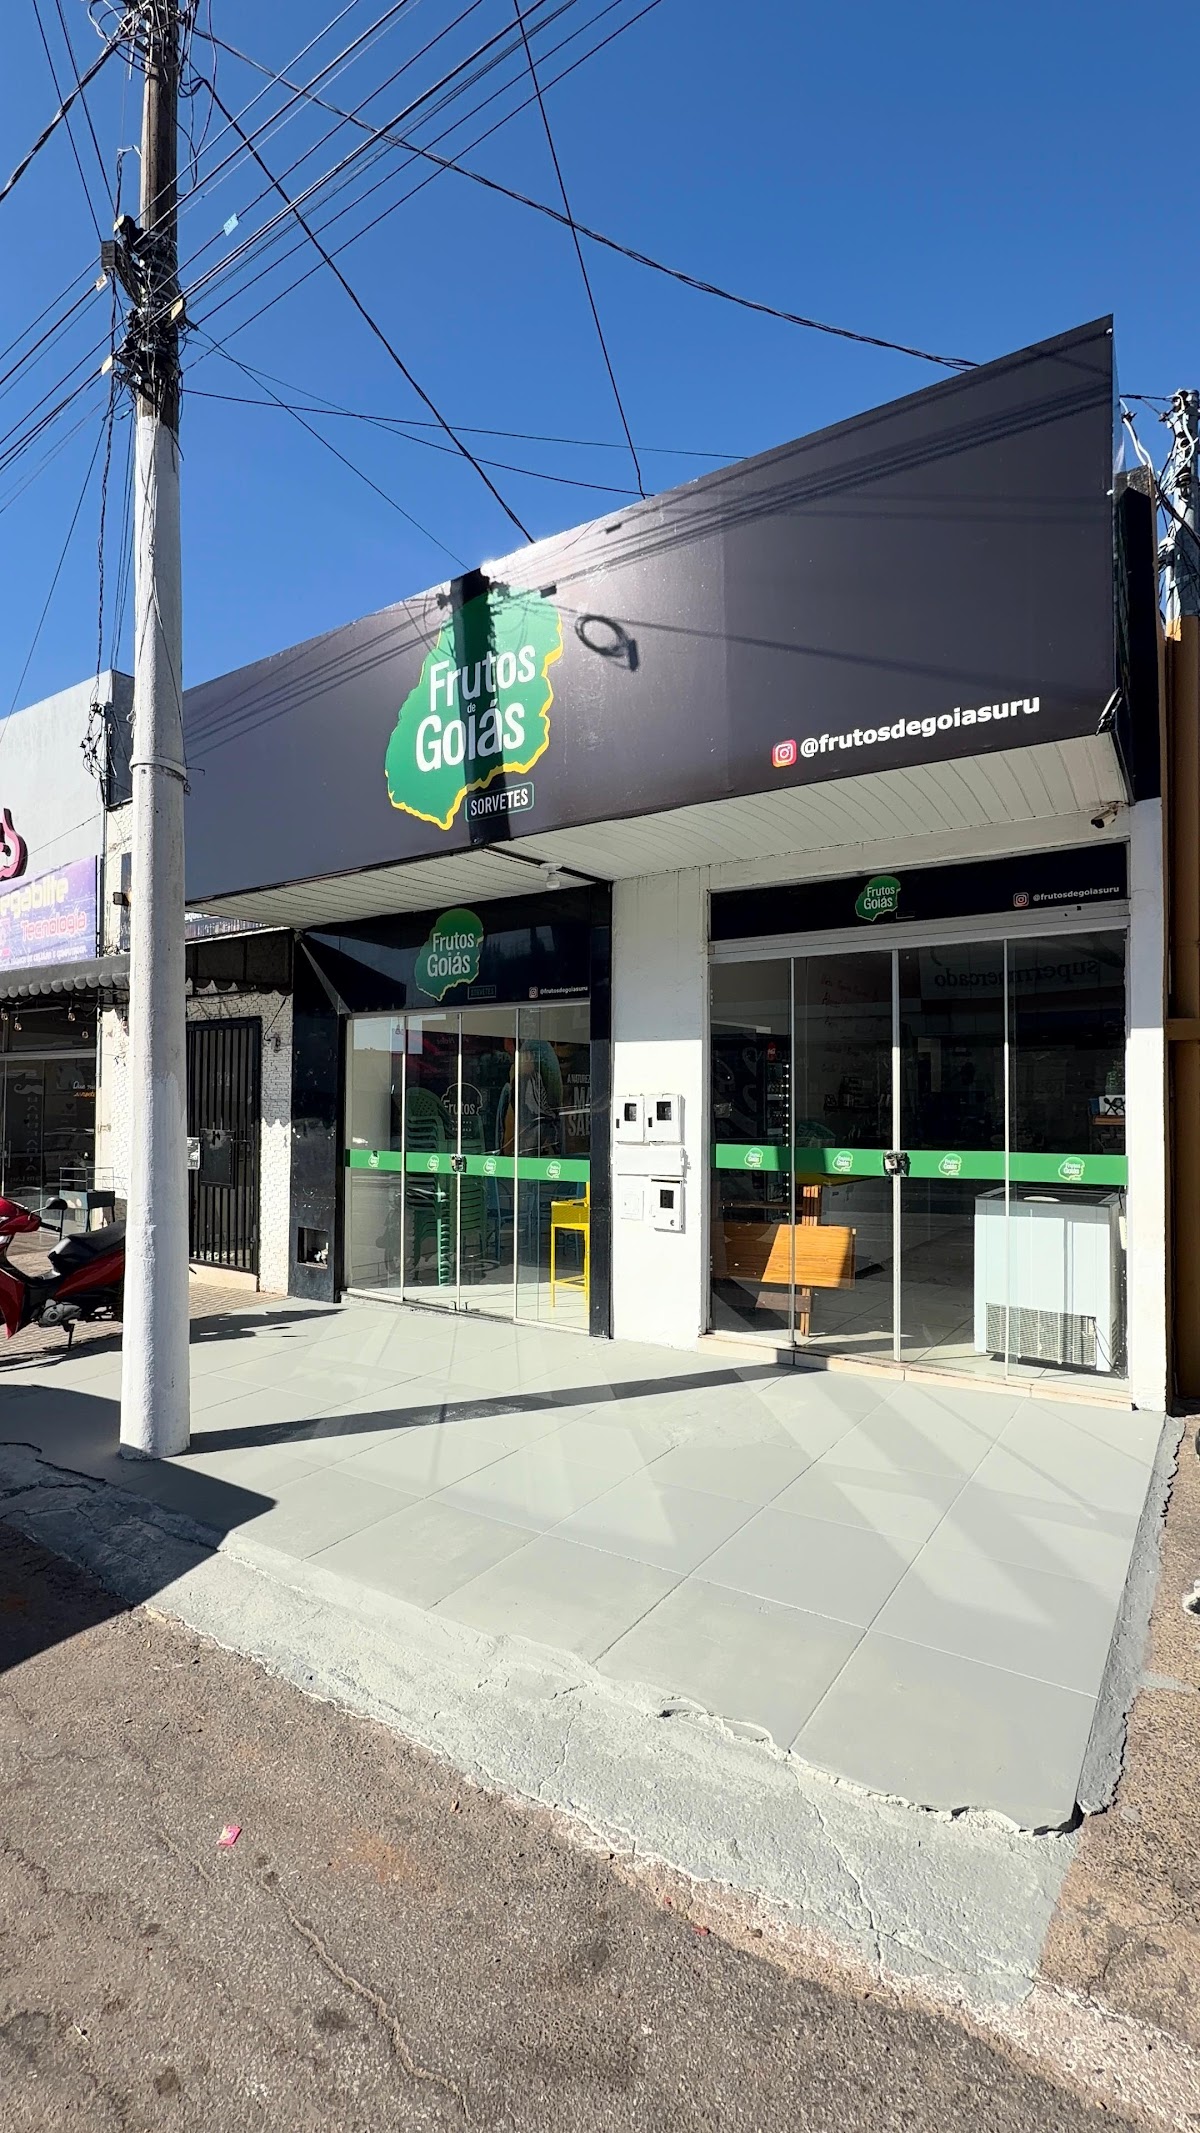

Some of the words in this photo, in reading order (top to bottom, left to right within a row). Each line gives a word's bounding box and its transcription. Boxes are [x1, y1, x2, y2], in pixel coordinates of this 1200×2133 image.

[430, 645, 536, 712] Frutos
[466, 702, 476, 713] de
[416, 698, 525, 773] Goiás
[800, 696, 1040, 758] @frutosdegoiasuru
[470, 788, 529, 816] SORVETES
[863, 896, 893, 910] Goiás
[867, 886, 896, 899] Frutos
[1032, 886, 1120, 902] @frutosdegoiasuru
[21, 911, 87, 941] Tecnologia
[432, 932, 475, 953] Frutos
[427, 952, 471, 978] Goiás
